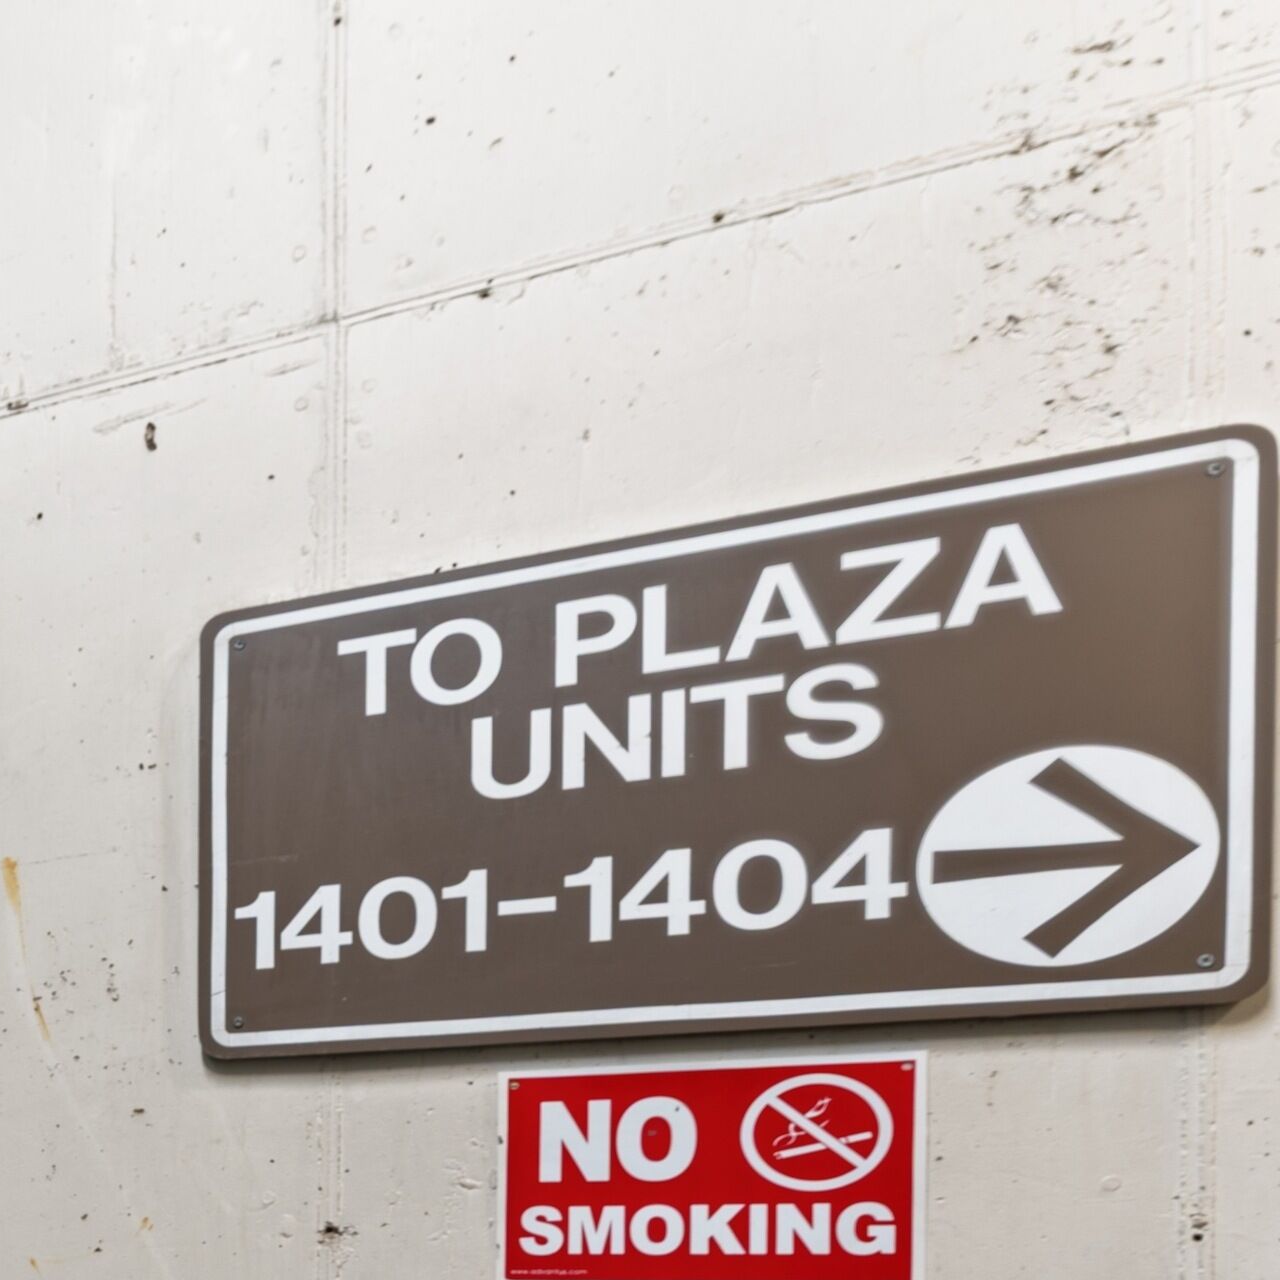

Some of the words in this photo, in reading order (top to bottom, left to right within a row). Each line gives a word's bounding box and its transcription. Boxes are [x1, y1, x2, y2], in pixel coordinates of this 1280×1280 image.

[336, 617, 503, 717] TO
[554, 522, 1064, 688] PLAZA
[470, 662, 884, 800] UNITS
[234, 827, 909, 970] 1401-1404
[538, 1096, 697, 1183] NO
[519, 1201, 897, 1256] SMOKING
